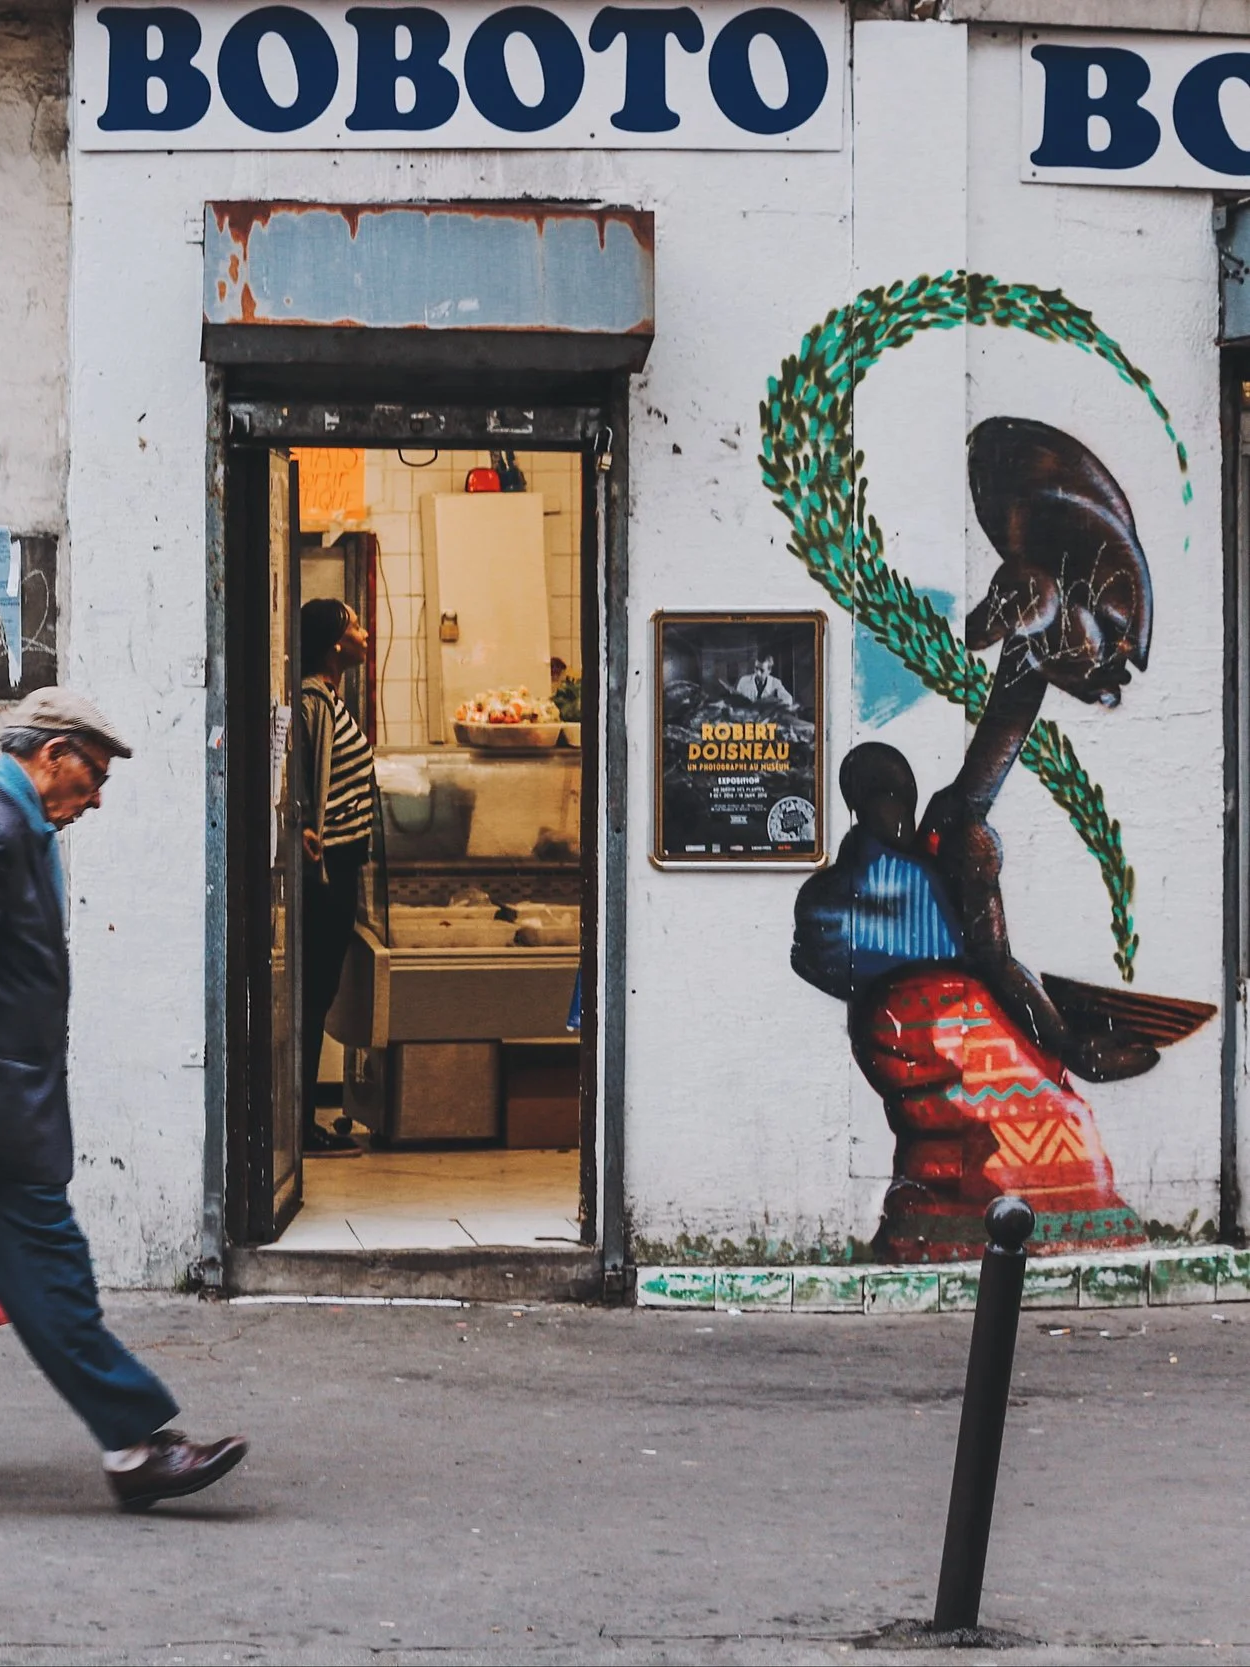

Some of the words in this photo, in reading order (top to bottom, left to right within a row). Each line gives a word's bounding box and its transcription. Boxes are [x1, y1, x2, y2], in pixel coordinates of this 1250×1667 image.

[96, 5, 829, 135] BOBOTO
[1030, 44, 1250, 176] BO
[701, 722, 777, 741] ROBERT
[688, 743, 790, 760] DOISNEAU
[687, 763, 697, 771] UN
[700, 763, 747, 771] PHOTOGRAPHE
[750, 763, 759, 771] AU
[718, 777, 760, 785] EXPOSITION
